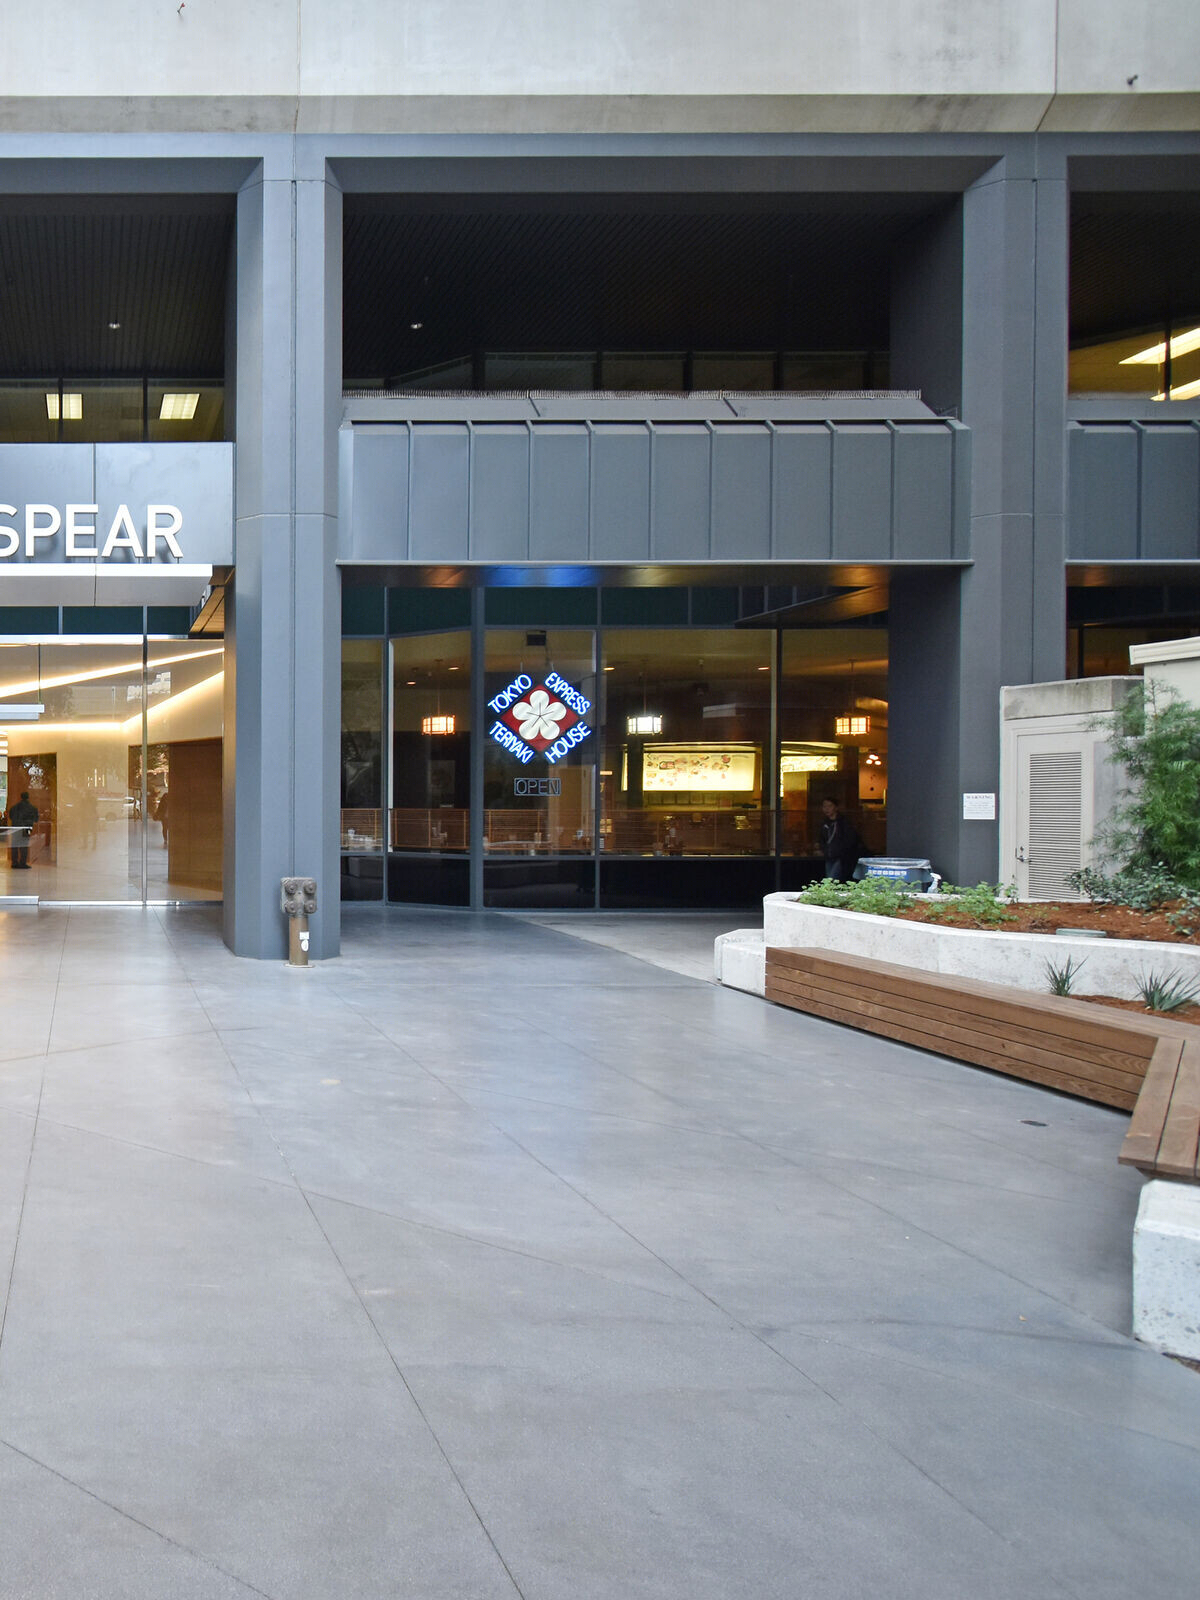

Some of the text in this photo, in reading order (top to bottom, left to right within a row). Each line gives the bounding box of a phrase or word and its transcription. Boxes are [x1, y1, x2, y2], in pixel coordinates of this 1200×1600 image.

[487, 671, 592, 716] TOKYO EXPRESS
[488, 720, 592, 764] TERIYAKI HOUSE
[516, 779, 559, 794] OPEN
